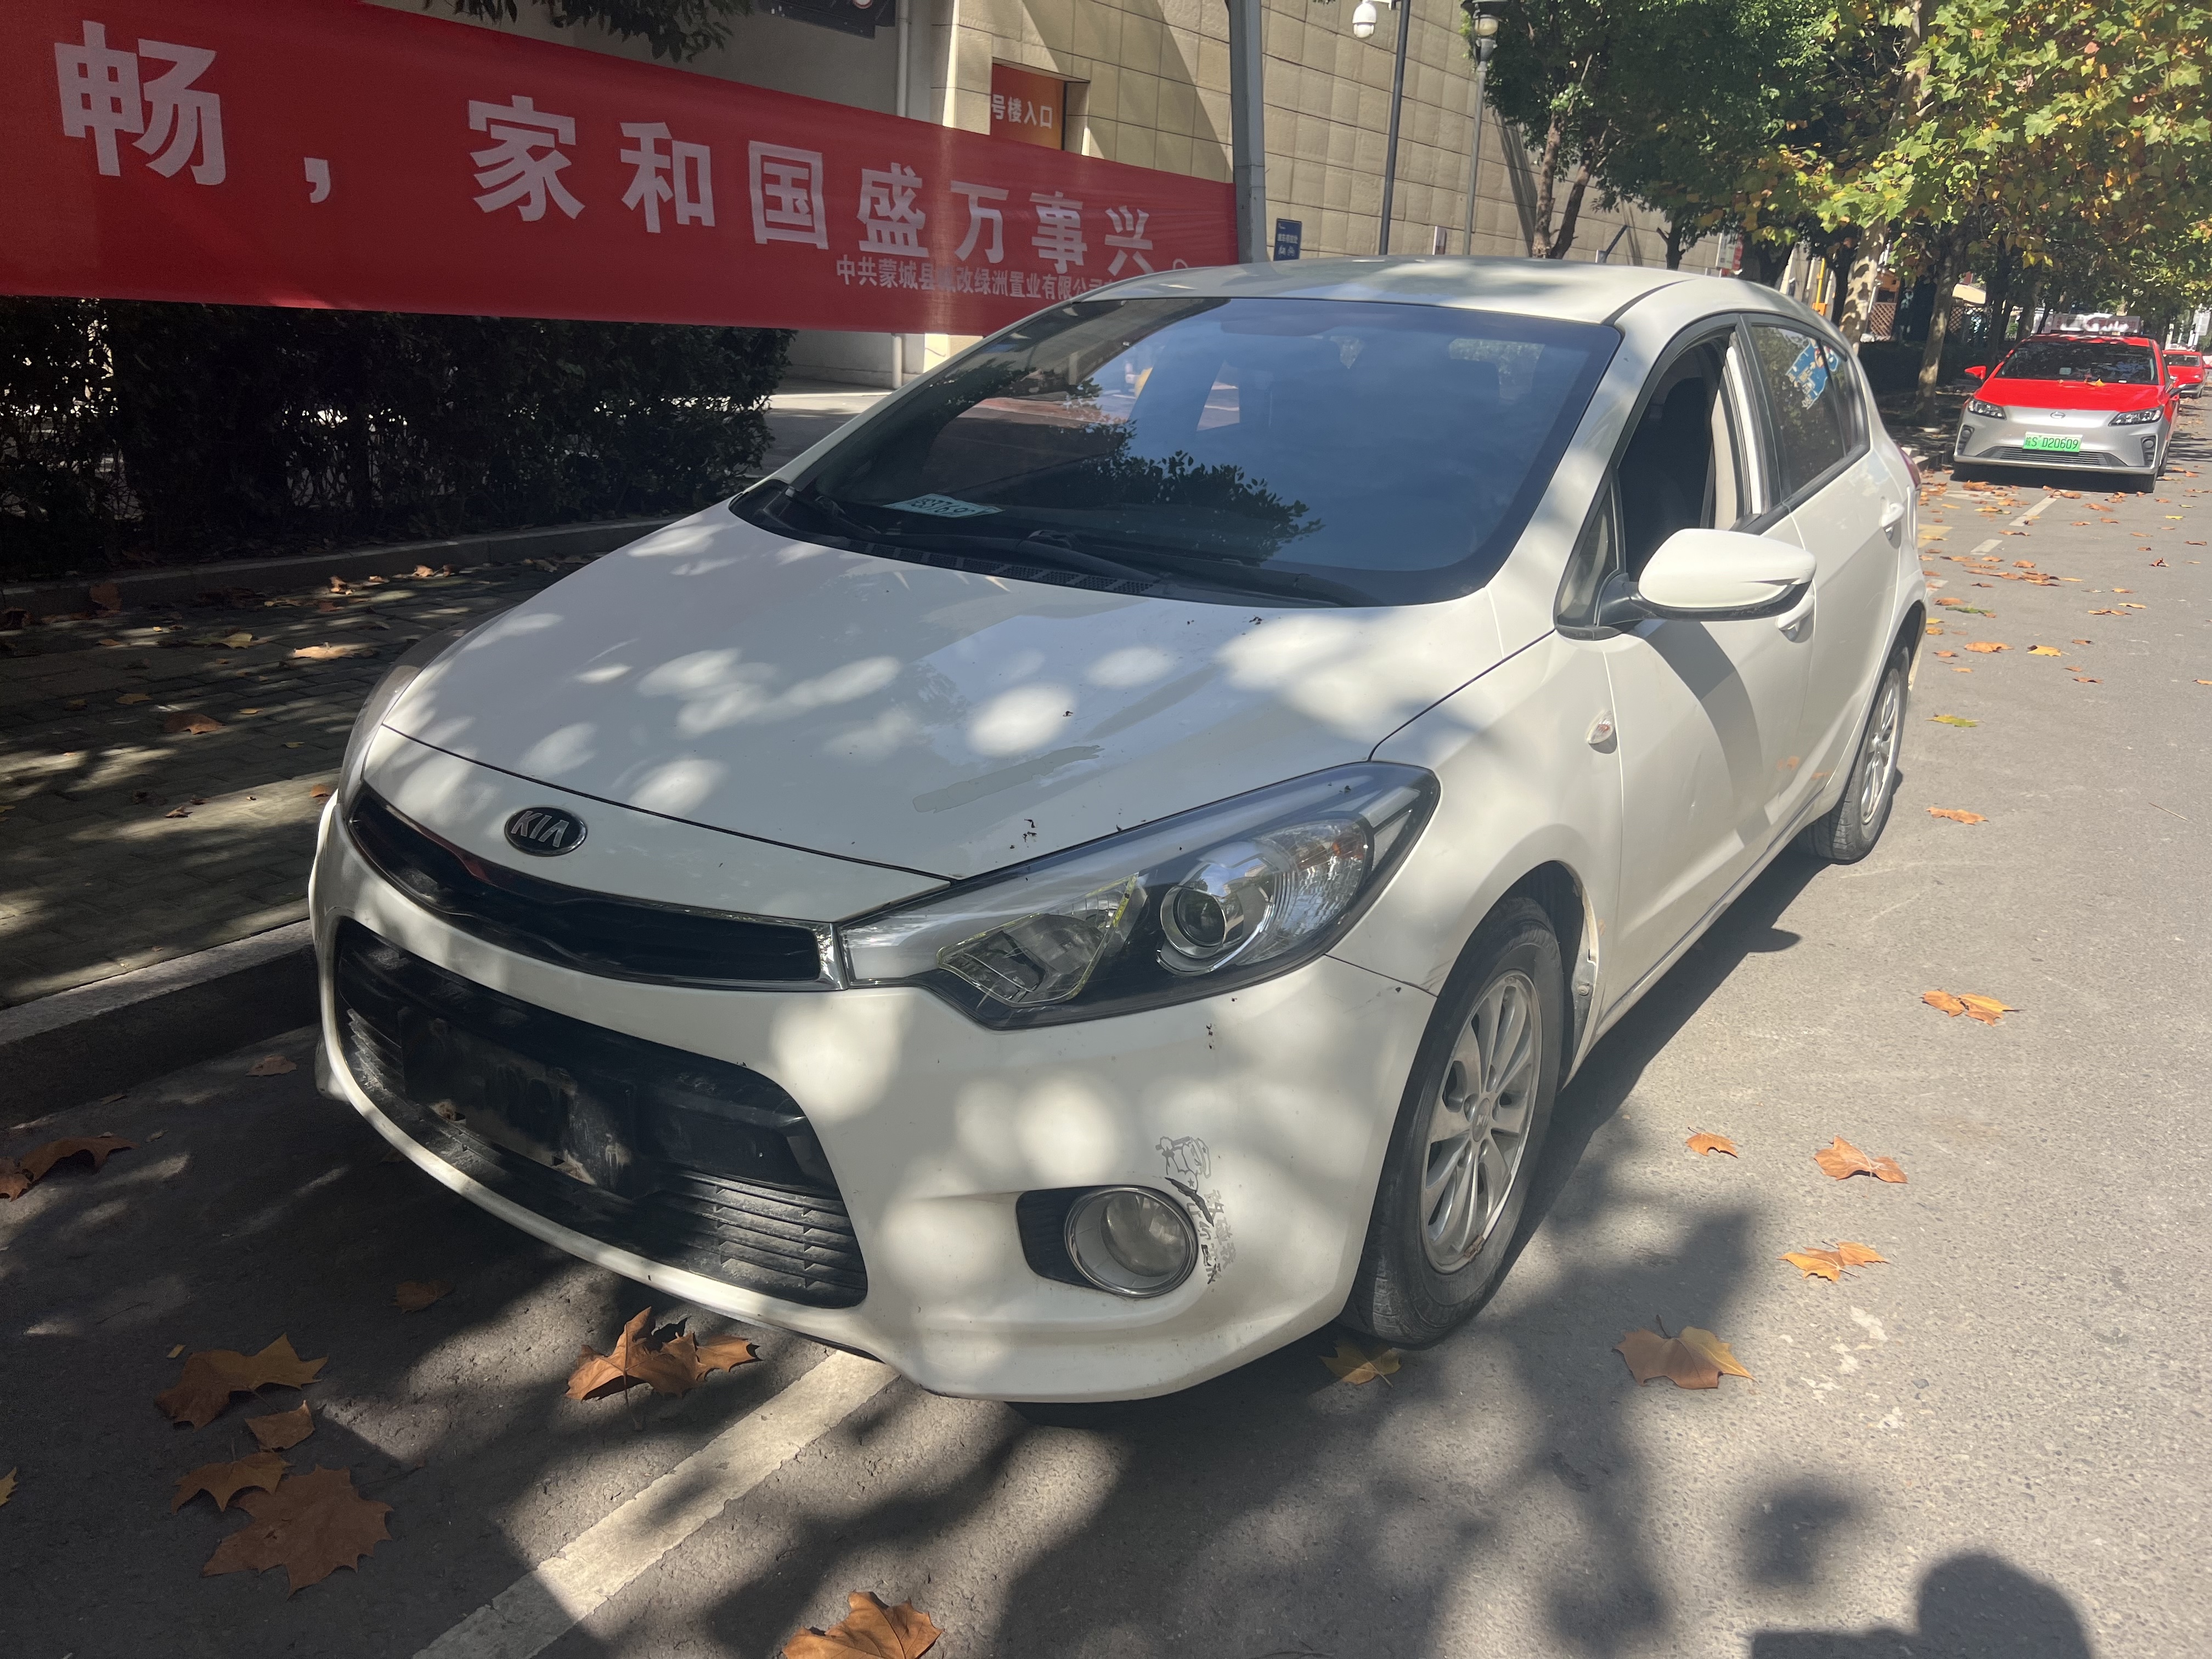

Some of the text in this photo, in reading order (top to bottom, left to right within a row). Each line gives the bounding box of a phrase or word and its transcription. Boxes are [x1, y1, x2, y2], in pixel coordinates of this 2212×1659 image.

[991, 94, 1053, 129] 号楼入口
[511, 810, 569, 848] KIA
